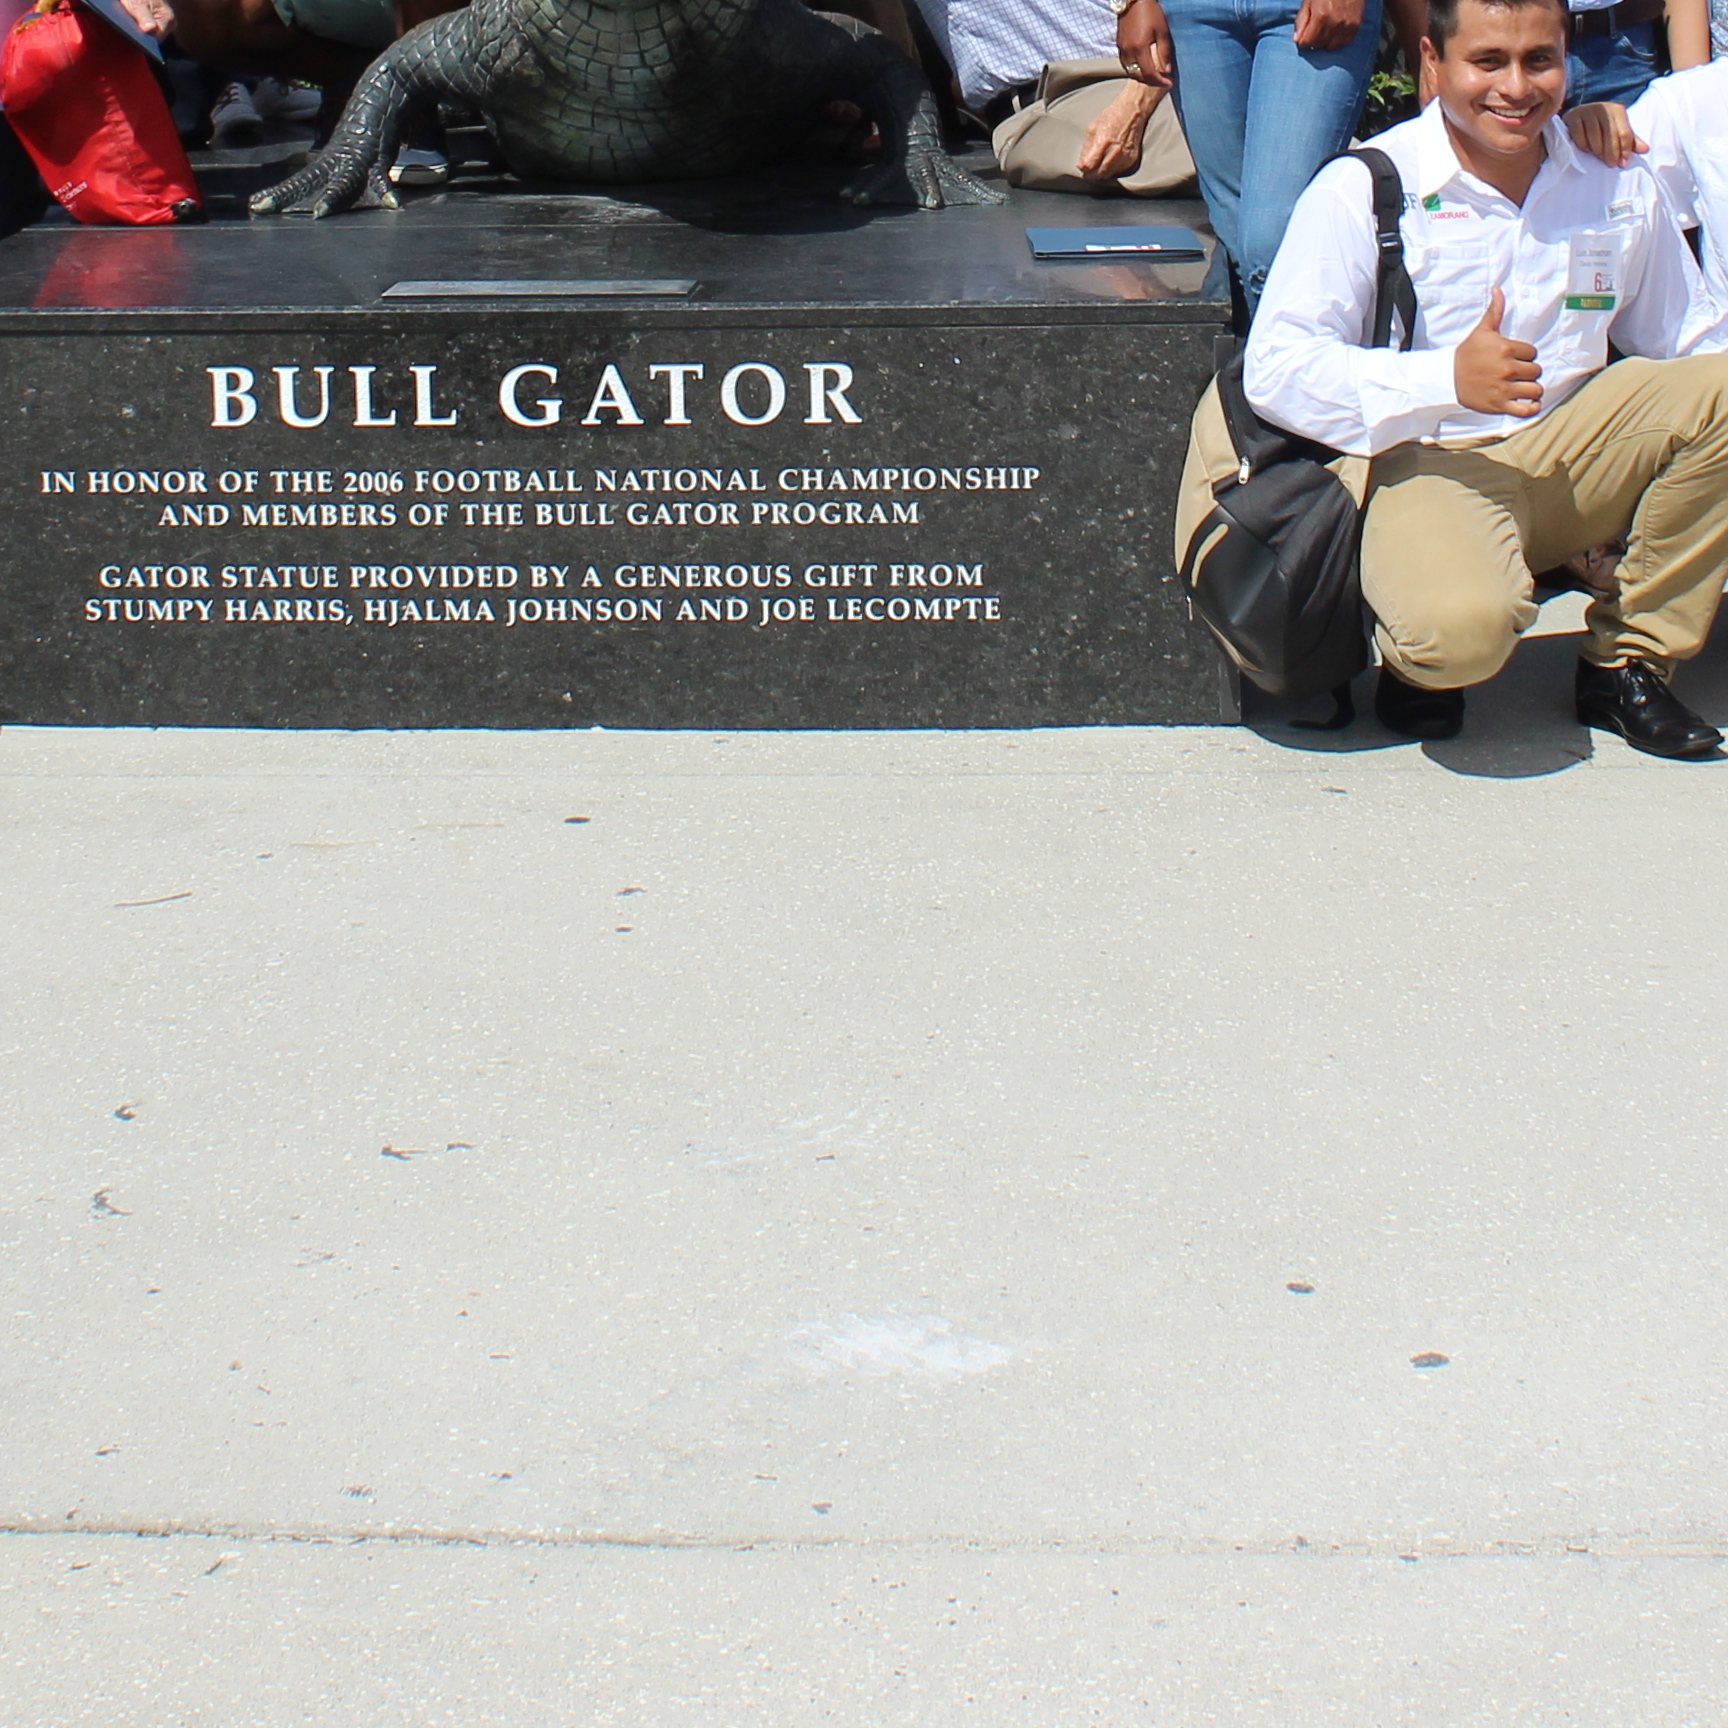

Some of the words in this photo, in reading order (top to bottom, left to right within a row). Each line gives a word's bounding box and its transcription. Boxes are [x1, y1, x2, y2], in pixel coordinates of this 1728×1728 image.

[207, 366, 458, 428] BULL
[500, 363, 864, 427] GATOR
[42, 471, 76, 493] IN
[89, 471, 209, 493] HONOR
[219, 470, 260, 493] OF
[270, 470, 334, 493] THE
[344, 471, 405, 494] 2006
[415, 470, 584, 493] FOOTBALL
[596, 469, 768, 492] NATIONAL
[779, 467, 1041, 491] CHAMPIONSHIP
[159, 504, 230, 526] AND
[242, 503, 398, 526] MEMBERS
[409, 503, 450, 526] OF
[460, 503, 524, 526] THE
[536, 503, 616, 526] BULL
[627, 502, 741, 526] GATOR
[752, 502, 920, 525] PROGRAM
[100, 565, 211, 588] GATOR
[222, 565, 340, 588] STATUE
[351, 565, 519, 588] PROVIDED
[531, 565, 570, 588] BY
[582, 566, 603, 588] A
[615, 564, 793, 588] GENEROUS
[805, 564, 879, 587] GIFT
[890, 564, 984, 587] FROM
[86, 598, 214, 621] STUMPY
[226, 599, 354, 626] HARRIS,
[365, 599, 496, 627] HJALMA
[507, 598, 663, 627] JOHNSON
[676, 596, 750, 621] AND
[760, 598, 816, 627] JOE
[828, 597, 1002, 621] LECOMPTE
